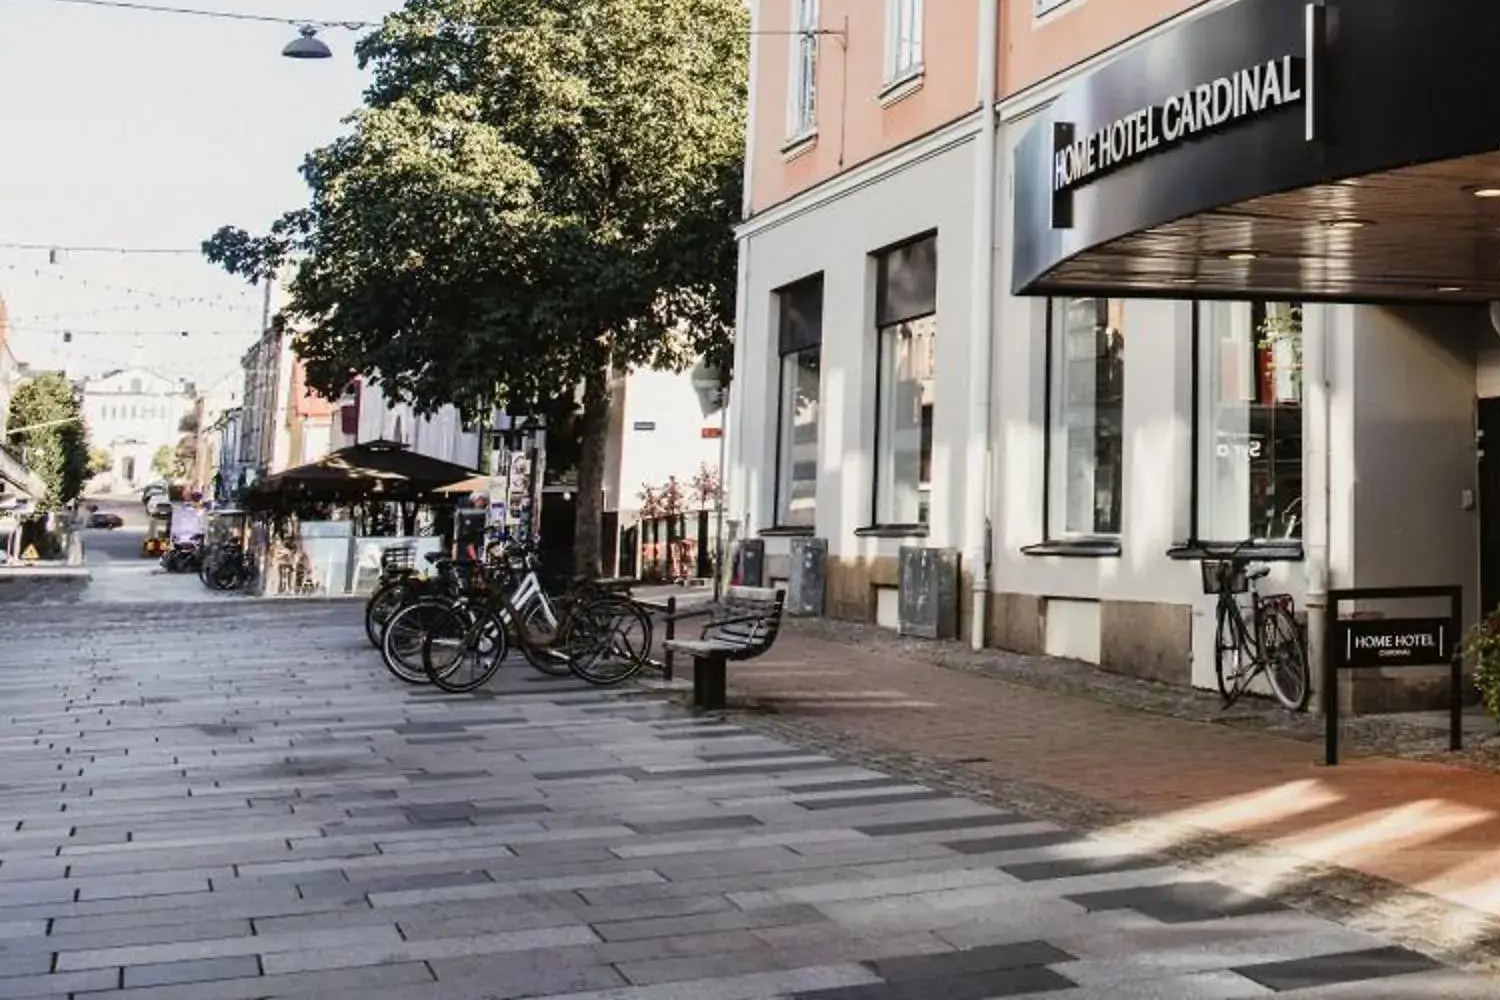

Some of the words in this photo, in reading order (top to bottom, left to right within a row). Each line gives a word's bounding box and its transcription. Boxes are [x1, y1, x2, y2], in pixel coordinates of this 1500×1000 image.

[1054, 130, 1096, 191] HOME
[1099, 105, 1159, 169] HOTEL
[1162, 55, 1301, 141] CARDINAL
[1355, 635, 1393, 649] HOME
[1395, 633, 1436, 648] HOTEL
[1378, 649, 1412, 657] CDNA
